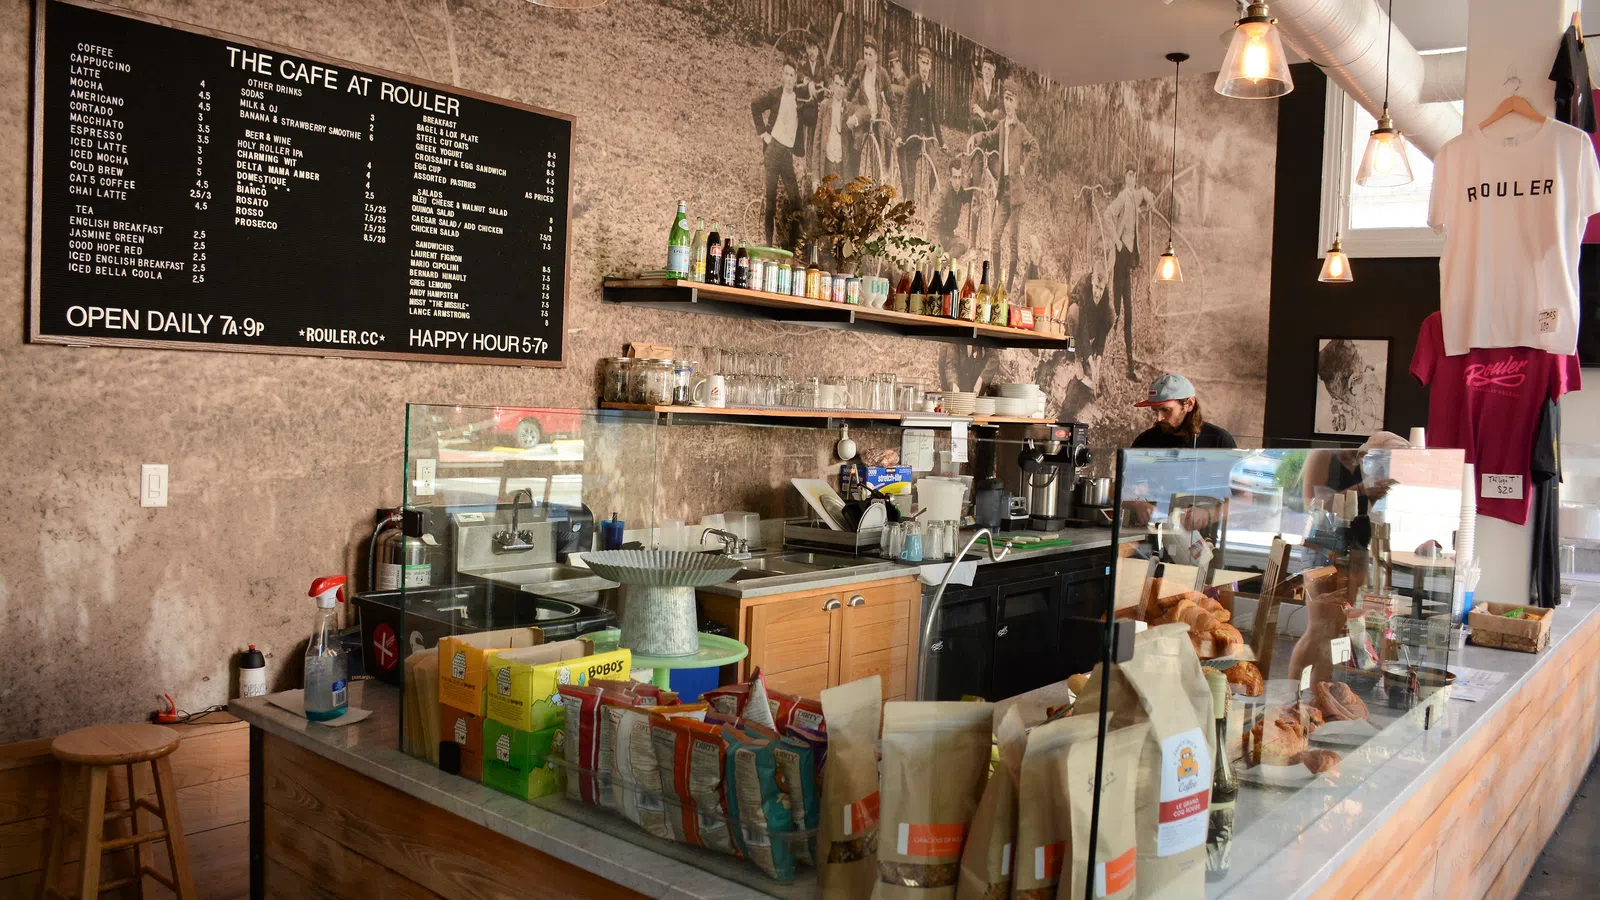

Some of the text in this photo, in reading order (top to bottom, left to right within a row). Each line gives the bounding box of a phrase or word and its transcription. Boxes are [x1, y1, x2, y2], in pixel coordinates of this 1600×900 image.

[78, 43, 113, 57] COFFEE
[70, 53, 131, 72] CAPPUCCINO
[71, 65, 211, 100] LATTE 4.5
[226, 46, 460, 117] THE CAFE AT ROULER
[248, 79, 302, 96] OTHER DRINKS
[70, 77, 211, 111] MOCHA 4.5
[70, 90, 124, 106] AMERICANO
[241, 88, 264, 99] SODAS
[240, 99, 278, 113] MILK & OJ
[70, 102, 210, 133] CORTADO 3.5
[240, 110, 270, 122] BANANA
[281, 118, 327, 132] STRAWBERRY
[328, 127, 362, 140] SMOOTHIE
[423, 115, 457, 129] BREAKFAST
[70, 113, 209, 144] MACCHIATO 3.5
[71, 125, 122, 141] ESPRESSO
[417, 124, 479, 143] BAGEL LOX PLATE
[71, 137, 127, 153] ICED LATTE
[245, 130, 292, 145] BEER & WINE
[416, 134, 469, 150] STEEL CUT OATS
[71, 149, 129, 165] ICED MOCHA
[238, 140, 303, 158] HOLY ROLLER IPA
[416, 143, 463, 158] GREEK YOGURT
[237, 150, 297, 166] CHARMING WIT
[415, 153, 507, 176] CROISSANT EGG SANDWICH
[70, 161, 209, 188] COLD BREW 4.5
[236, 160, 320, 181] DELTA MAMA AMBER
[414, 162, 442, 173] EGG CUP
[70, 174, 88, 183] CAT
[90, 176, 96, 184] 5
[100, 178, 135, 189] COFFEE
[237, 171, 286, 186] DOMESTIQUE
[237, 185, 267, 196] BIANCO
[414, 172, 447, 184] ASSORTED
[450, 178, 476, 189] PASTRIES
[534, 193, 554, 203] PRICED
[417, 189, 443, 198] SALADS
[1467, 179, 1553, 202] ROULER
[70, 186, 208, 210] CHAI LATTE 4.5
[236, 196, 269, 207] ROSATO
[76, 205, 94, 214] TEA
[236, 206, 264, 217] ROSSO
[412, 205, 455, 217] QUINOA SALAD
[432, 198, 454, 208] CHEESE
[462, 203, 486, 213] WALNUT
[489, 207, 508, 216] SALAD
[70, 216, 206, 239] ENGLISH BREAKFAST 2.5
[235, 217, 278, 230] PROSECCO
[411, 224, 460, 237] CHICKEN SALAD
[412, 215, 436, 224] CAESAR
[439, 219, 457, 228] SALAD
[478, 225, 503, 234] CHICKEN
[70, 228, 206, 250] JASMINE GREEN 2.5
[415, 240, 454, 252] SANDWICHES
[69, 240, 206, 261] GOOD HOPE RED 2.5
[411, 250, 438, 259] LAURENT
[69, 251, 206, 272] ICED ENGLISH BREAKFAST 2.5
[410, 259, 459, 271] MARIO CIPOLINI
[69, 263, 204, 283] ICED BELLA COOLA 2.5
[410, 269, 467, 282] BERNARD HINAULT
[410, 279, 452, 289] GREG LEMOND
[427, 290, 458, 299] HAMPSTEN
[66, 306, 139, 330] OPEN
[148, 311, 214, 334] DAILY
[409, 308, 470, 319] LANCE ARMSTRONG
[410, 329, 469, 349] HAPPY
[473, 333, 520, 352] HOUR
[1497, 486, 1513, 494] $20
[588, 660, 624, 678] BOBO'S
